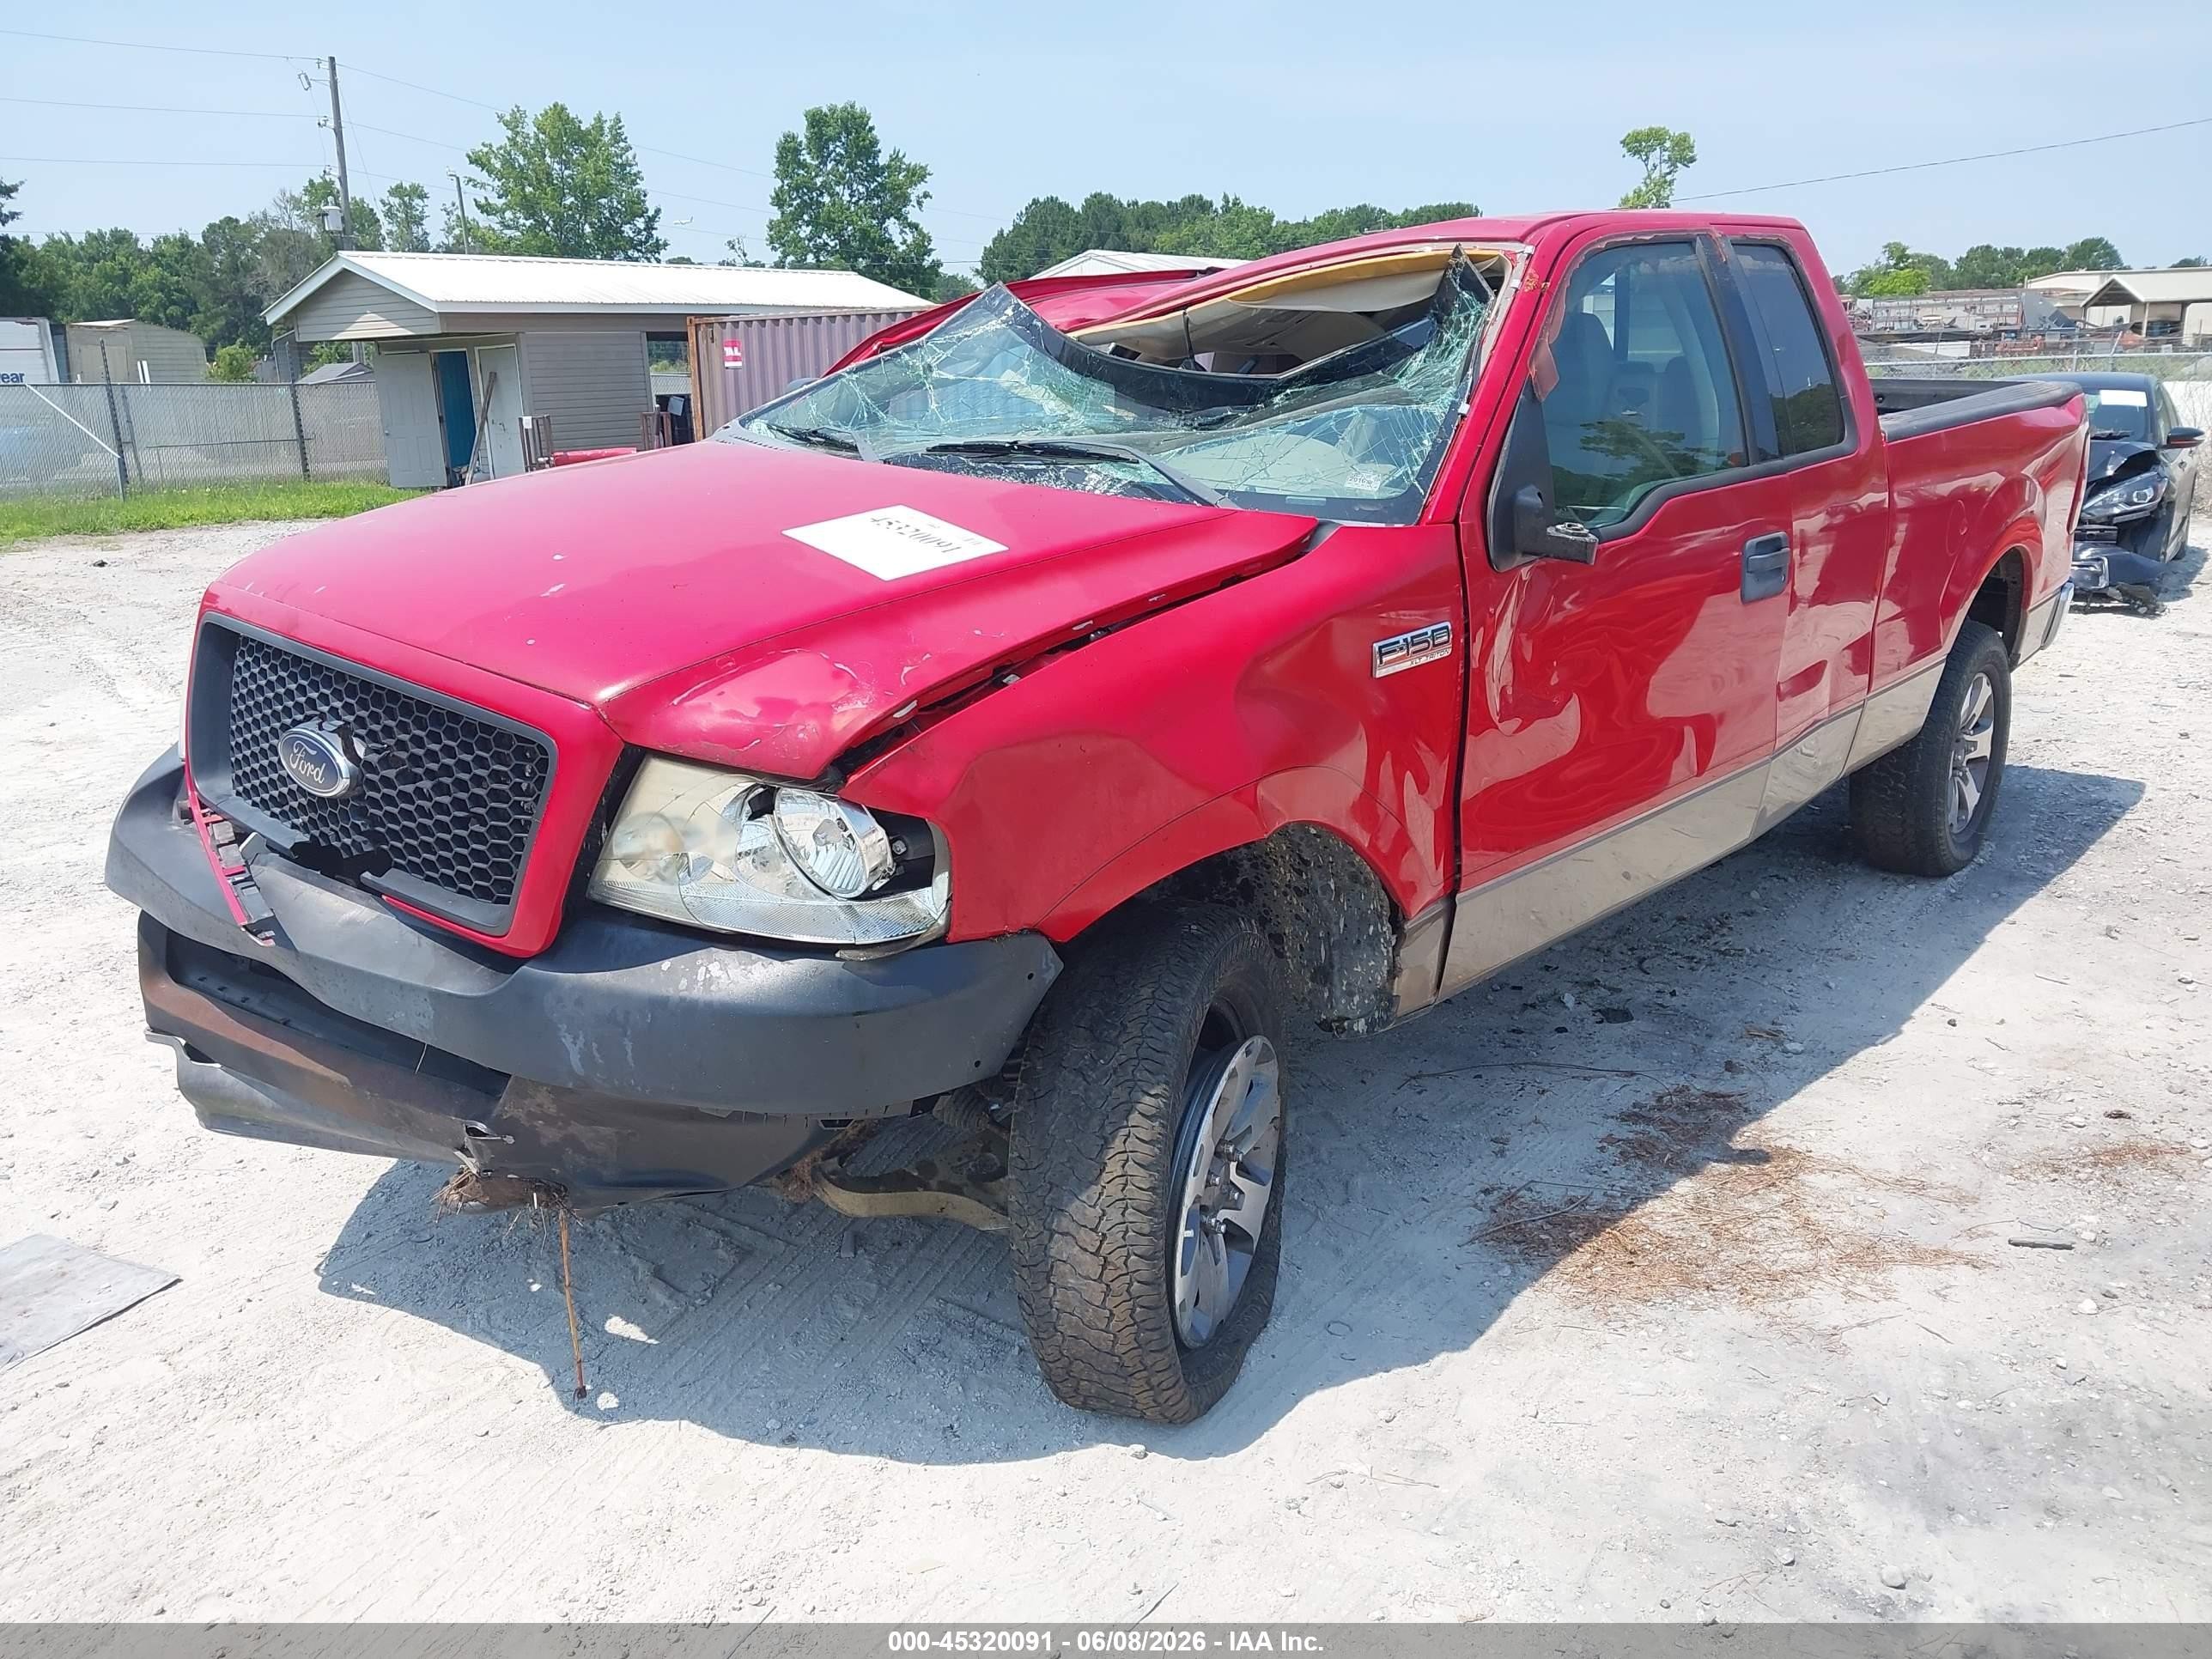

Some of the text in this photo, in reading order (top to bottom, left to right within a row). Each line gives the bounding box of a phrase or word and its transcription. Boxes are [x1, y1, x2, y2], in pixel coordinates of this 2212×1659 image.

[0, 373, 25, 383] ear
[870, 516, 962, 553] 45320091
[289, 740, 326, 784] Ford
